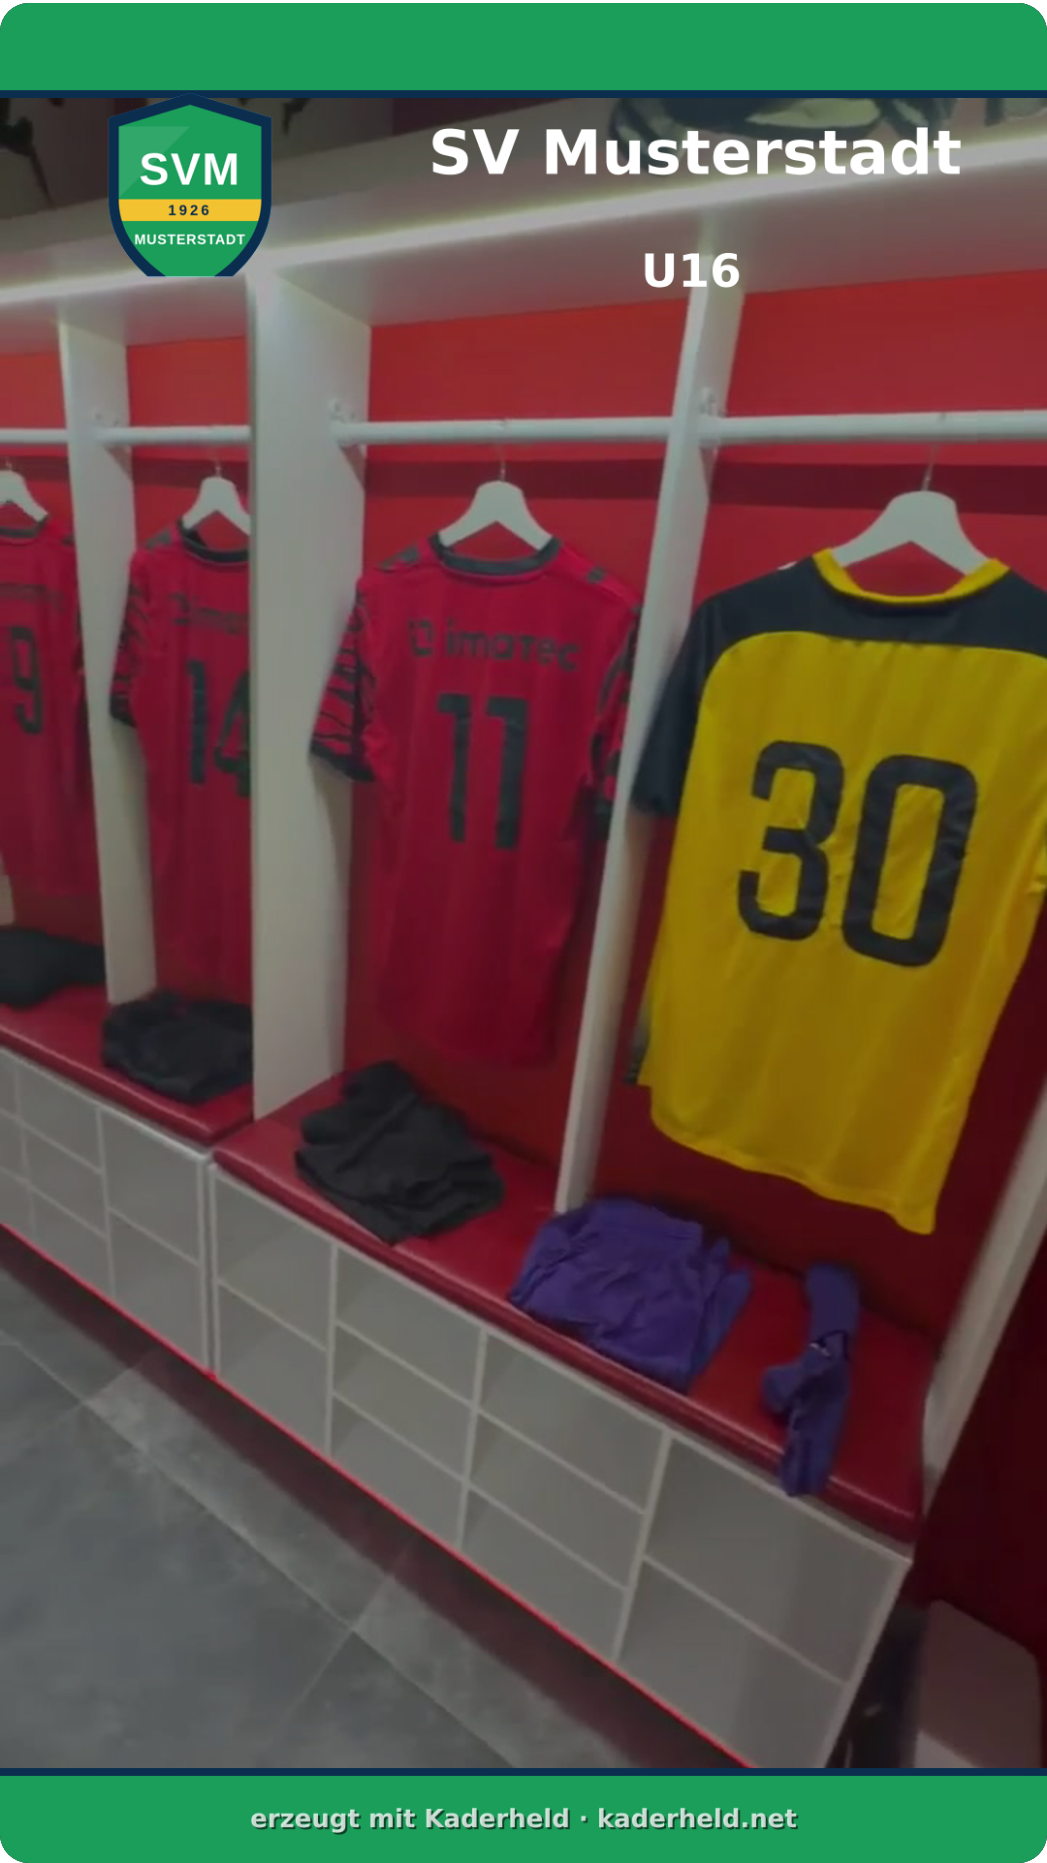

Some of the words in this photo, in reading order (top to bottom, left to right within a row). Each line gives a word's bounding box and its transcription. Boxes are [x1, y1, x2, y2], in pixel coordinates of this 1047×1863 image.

[10, 626, 43, 734] 9
[186, 659, 251, 797] 14
[436, 693, 528, 850] 11
[738, 740, 978, 967] 30
